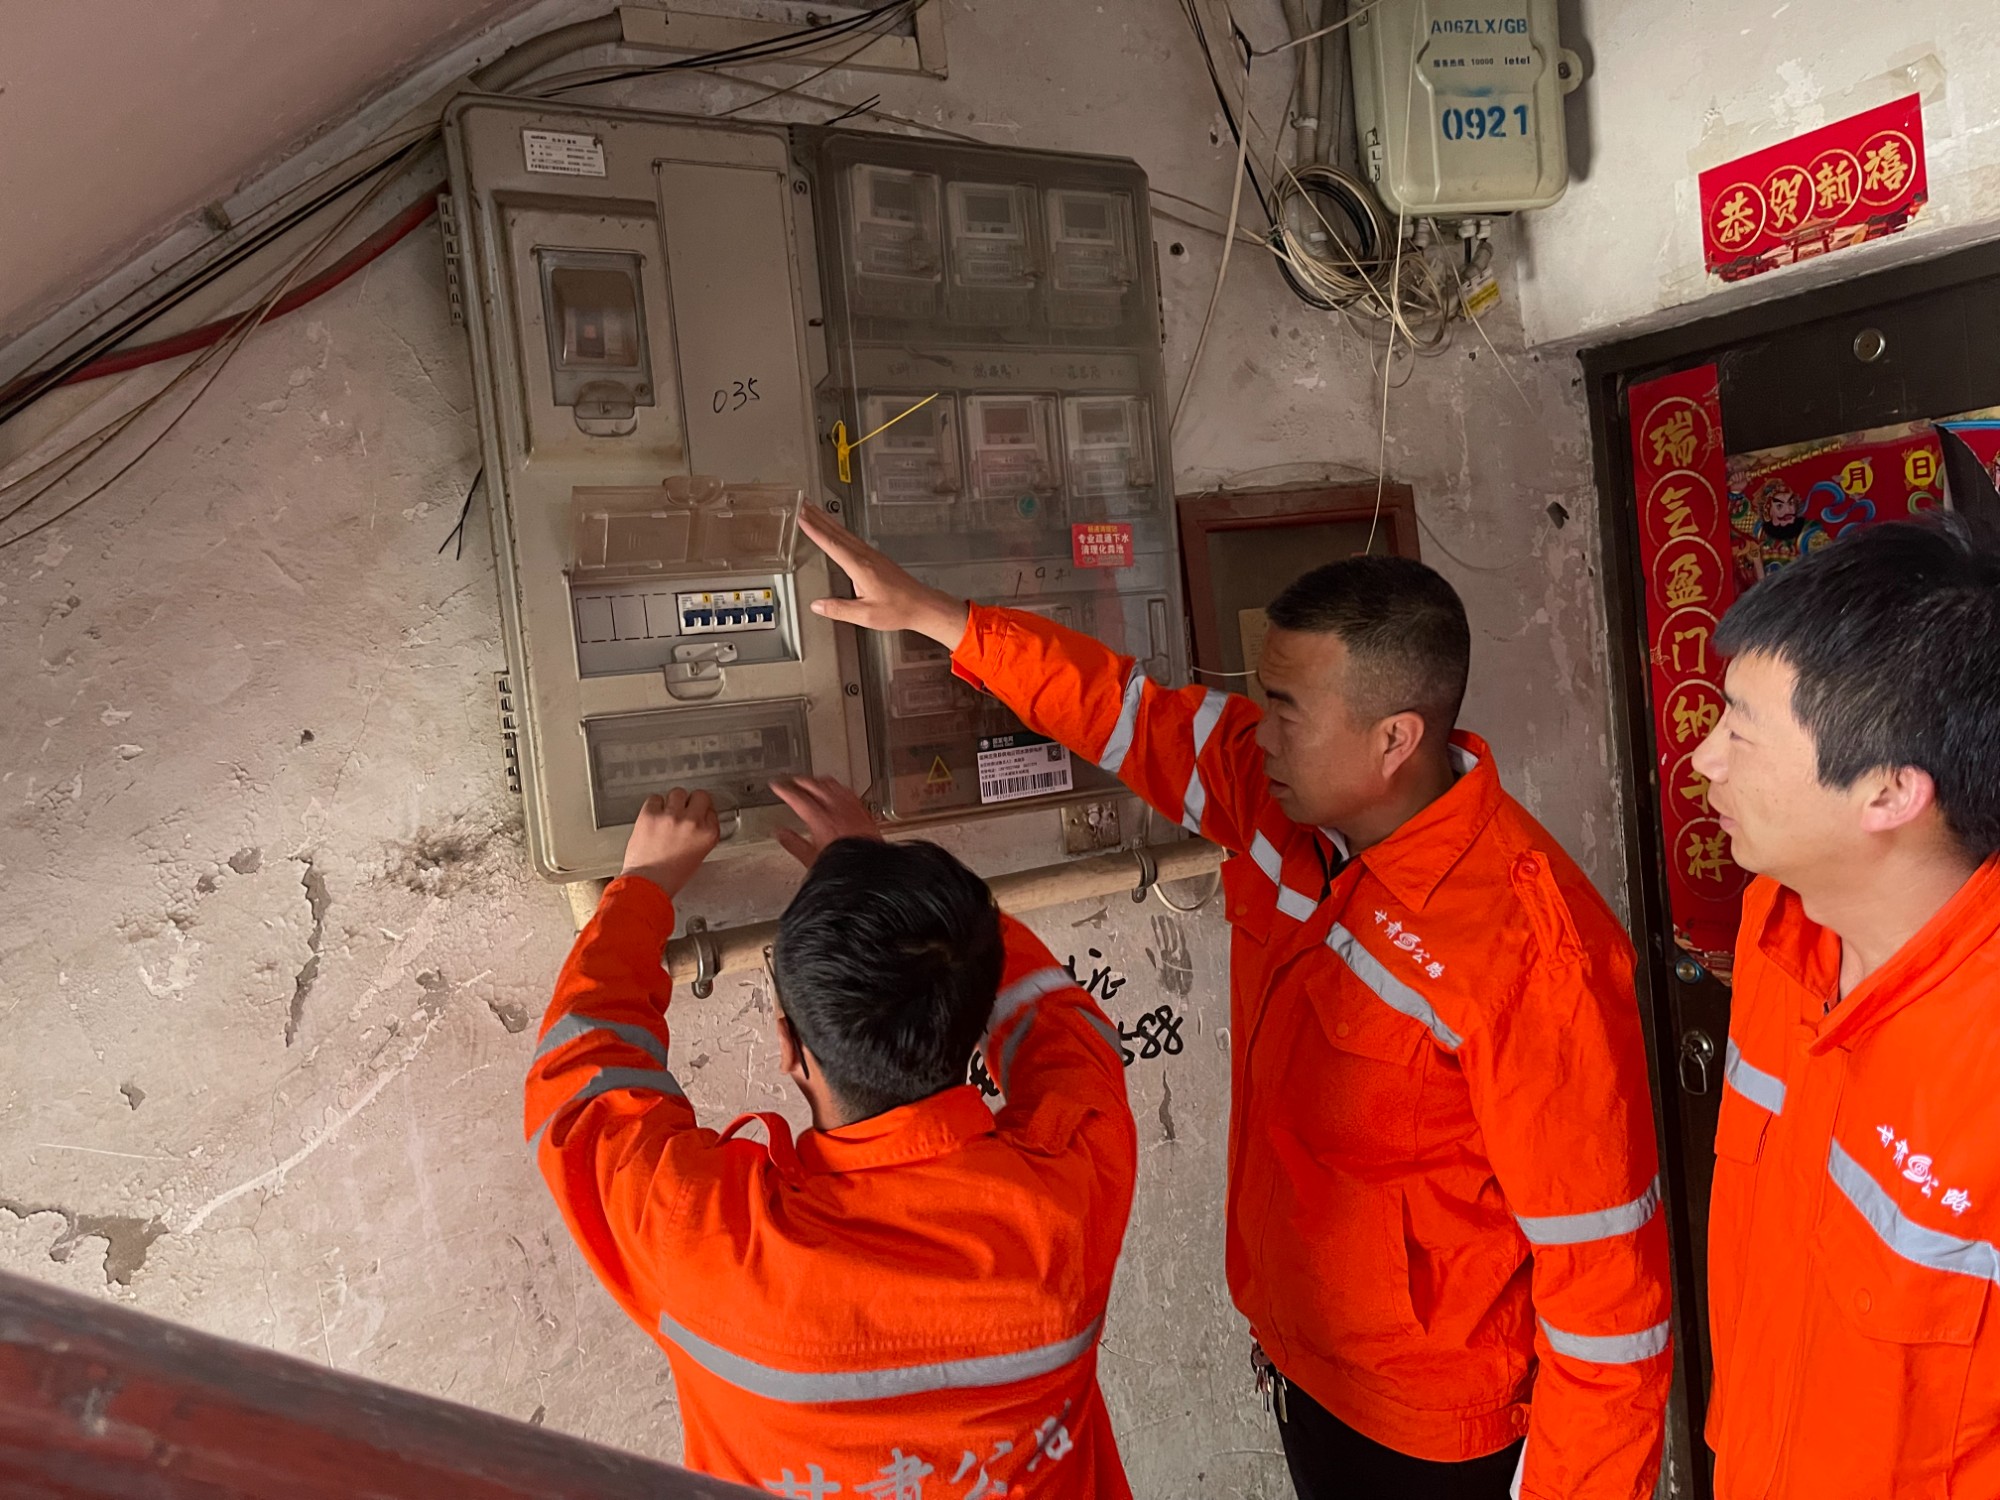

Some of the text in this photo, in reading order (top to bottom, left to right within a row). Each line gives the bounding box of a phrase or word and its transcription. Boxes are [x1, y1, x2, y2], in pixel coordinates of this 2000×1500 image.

[1431, 18, 1528, 35] A06ZLX/GB
[1471, 58, 1494, 66] 10000
[1442, 103, 1529, 140] 0921
[1716, 140, 1909, 244] 恭贺新禧
[712, 377, 761, 415] 035
[1845, 456, 1931, 491] 月 日
[1078, 533, 1130, 544] 专业疏通下水
[1080, 544, 1125, 555] 清理化粪池
